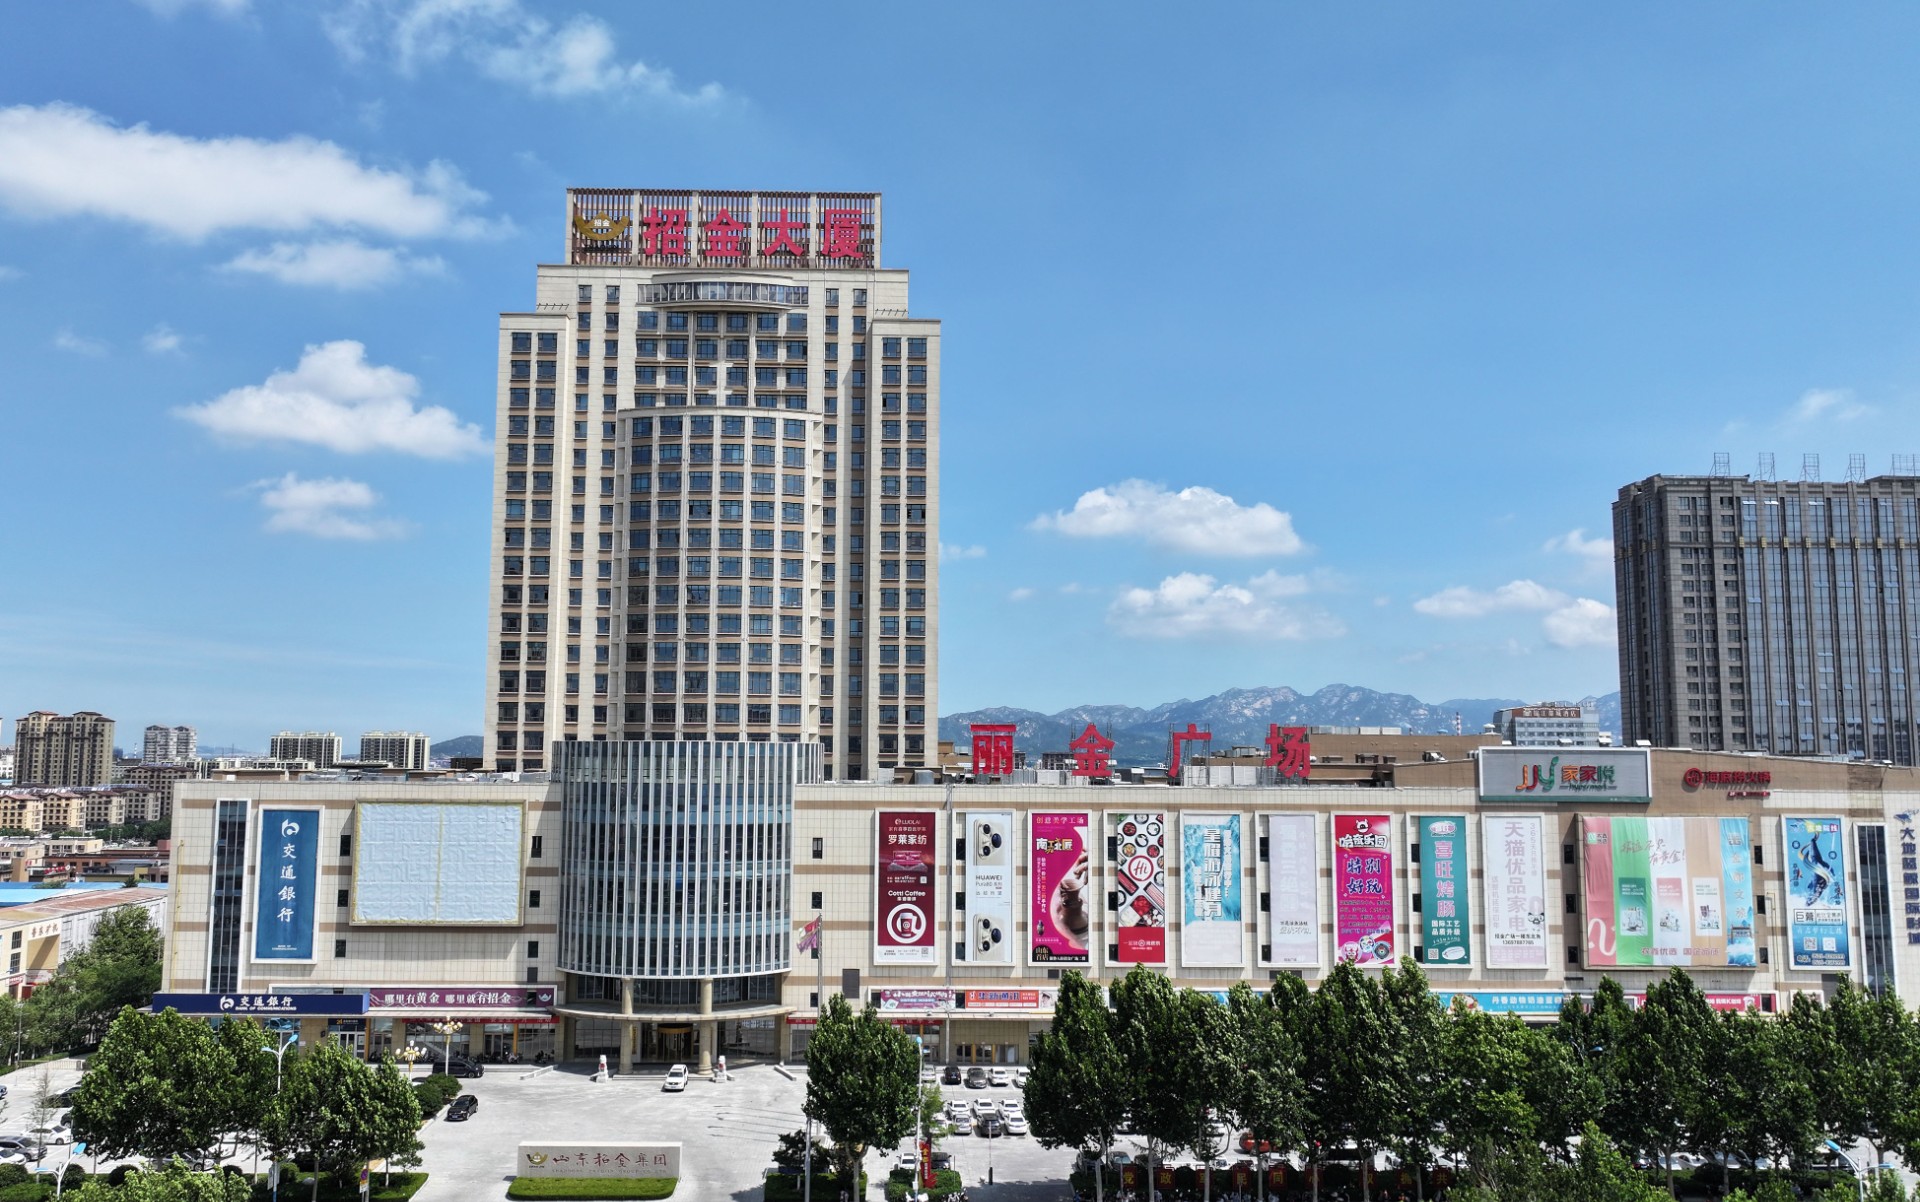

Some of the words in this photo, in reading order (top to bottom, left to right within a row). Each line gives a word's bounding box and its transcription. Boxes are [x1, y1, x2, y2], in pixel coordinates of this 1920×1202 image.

[594, 219, 610, 227] 招金
[642, 207, 864, 259] 招金大厦
[970, 722, 1311, 779] 丽金广场
[1561, 765, 1616, 783] 家家悦
[888, 834, 927, 845] 罗莱家纺
[1347, 857, 1381, 875] 特别
[277, 843, 297, 922] 交通銀行
[1347, 877, 1383, 893] 好玩
[1434, 841, 1456, 918] 喜旺烤肠
[1504, 821, 1528, 933] 天猫优品家电
[240, 995, 293, 1007] 交通銀行
[384, 992, 440, 1004] 哪里有黄金
[445, 992, 511, 1004] 哪里就有招金
[552, 1152, 667, 1168] 山东招金集团
